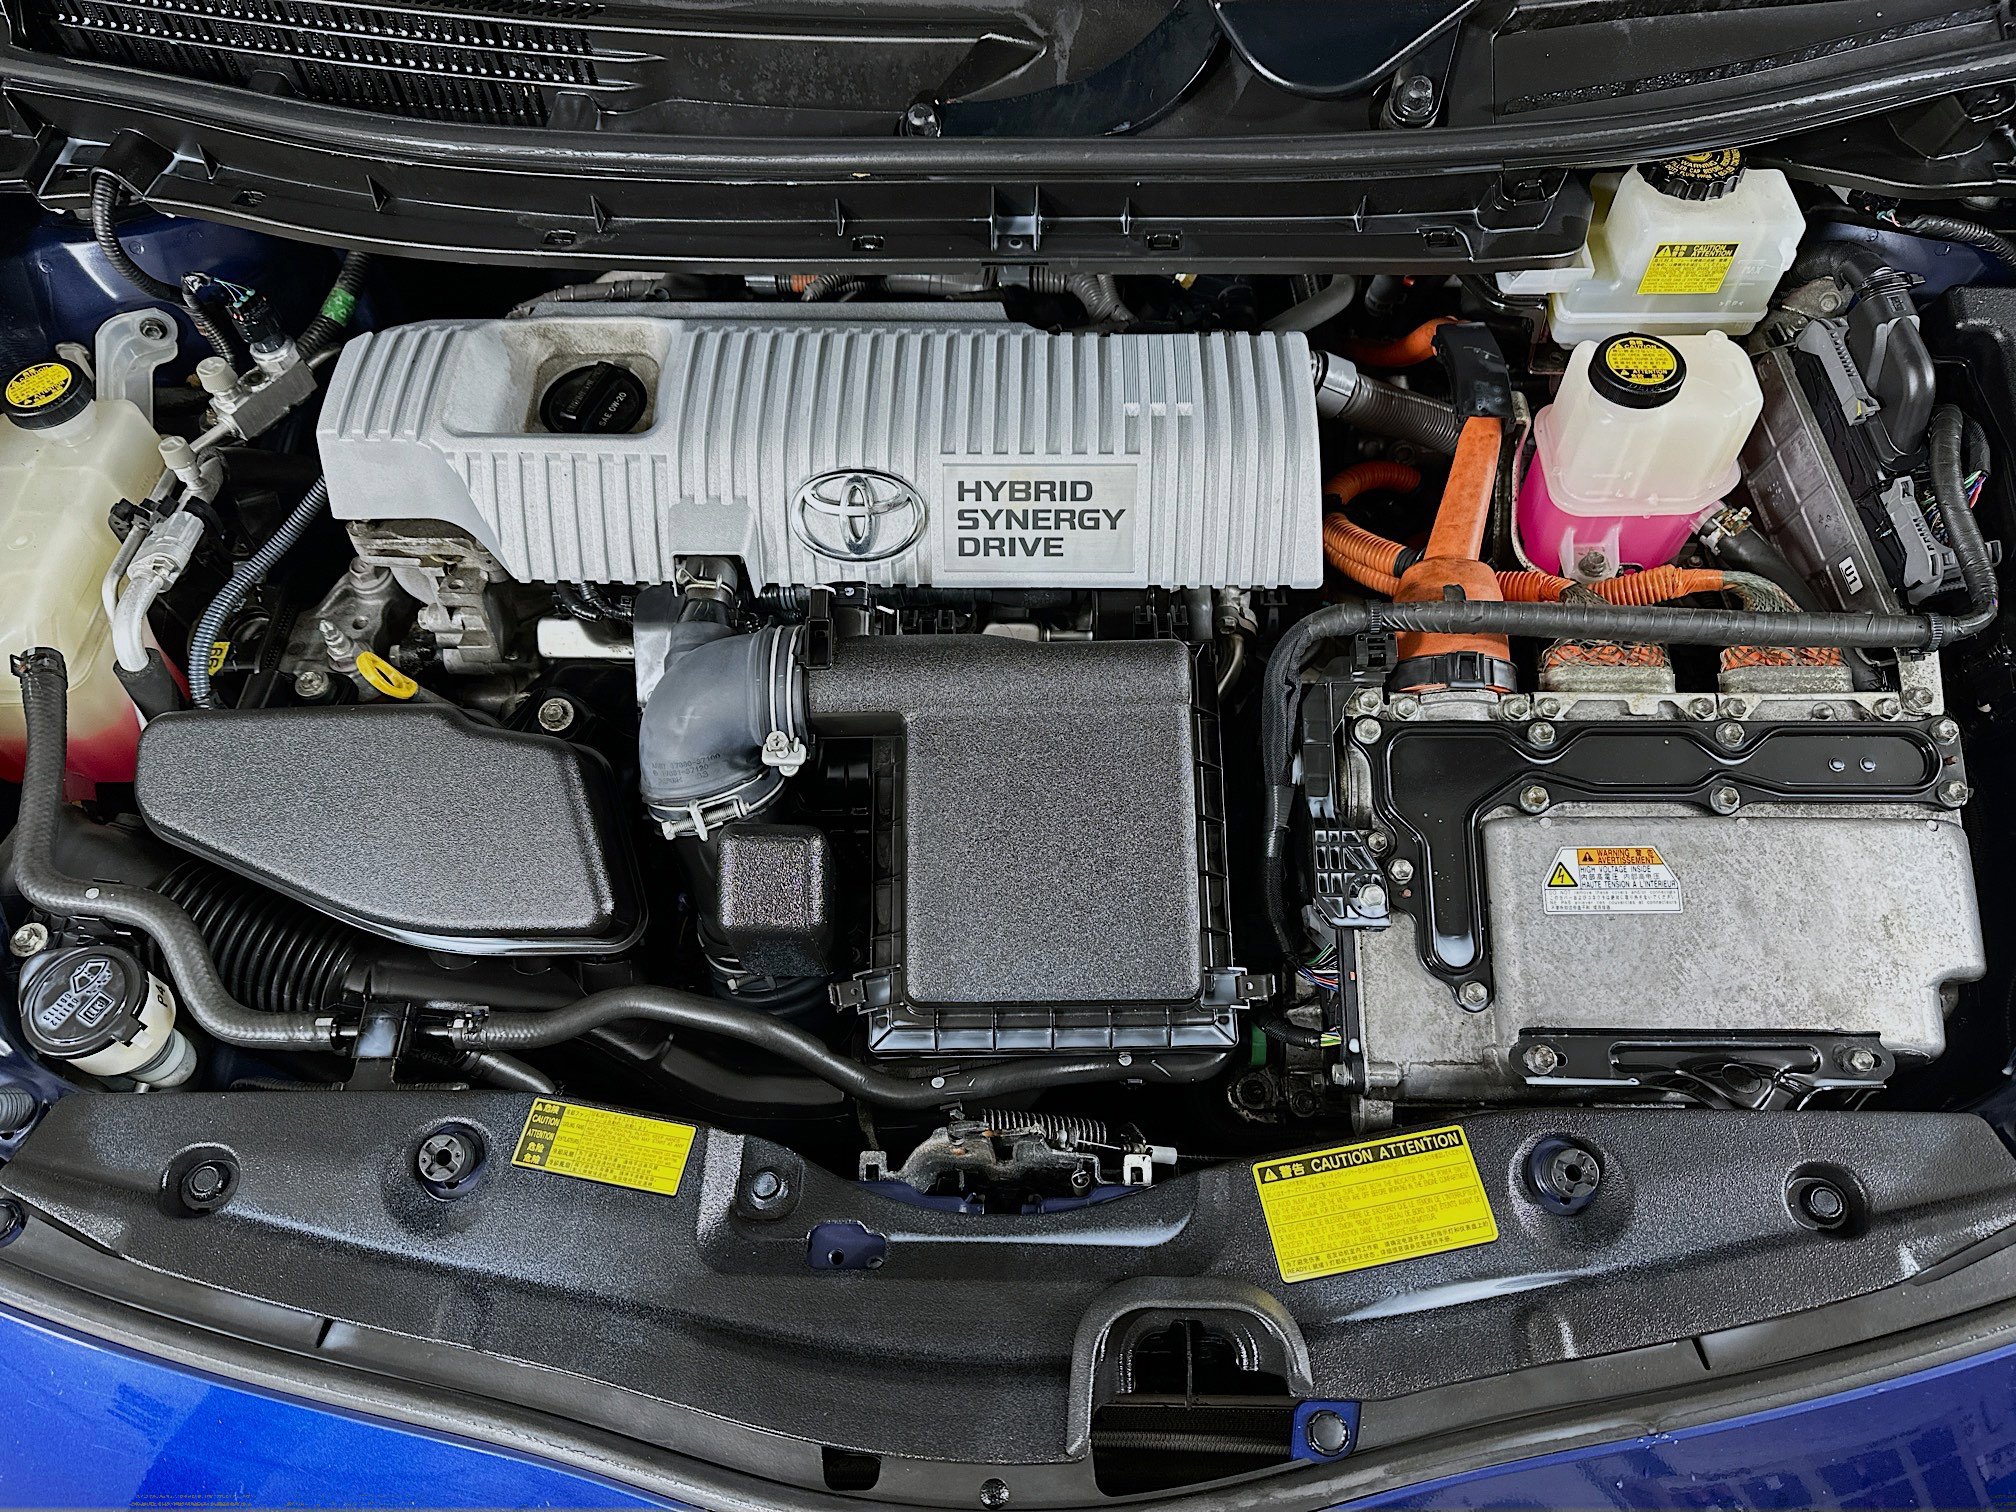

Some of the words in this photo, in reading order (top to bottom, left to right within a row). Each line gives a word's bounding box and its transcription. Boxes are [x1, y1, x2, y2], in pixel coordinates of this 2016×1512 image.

[599, 413, 612, 427] SAE
[608, 392, 627, 412] 0W-20
[957, 480, 1093, 502] HYBRID
[957, 508, 1126, 530] SYNERGY
[957, 537, 1064, 557] DRIVE
[1844, 564, 1858, 585] U1
[1596, 849, 1630, 858] WARNING
[1581, 881, 1602, 889] HAUTE
[155, 984, 168, 1008] P4
[531, 1113, 560, 1126] CAUTION
[525, 1127, 555, 1141] ATTENTION
[1309, 1148, 1373, 1172] CAUTION
[1376, 1131, 1460, 1159] ATTENTION
